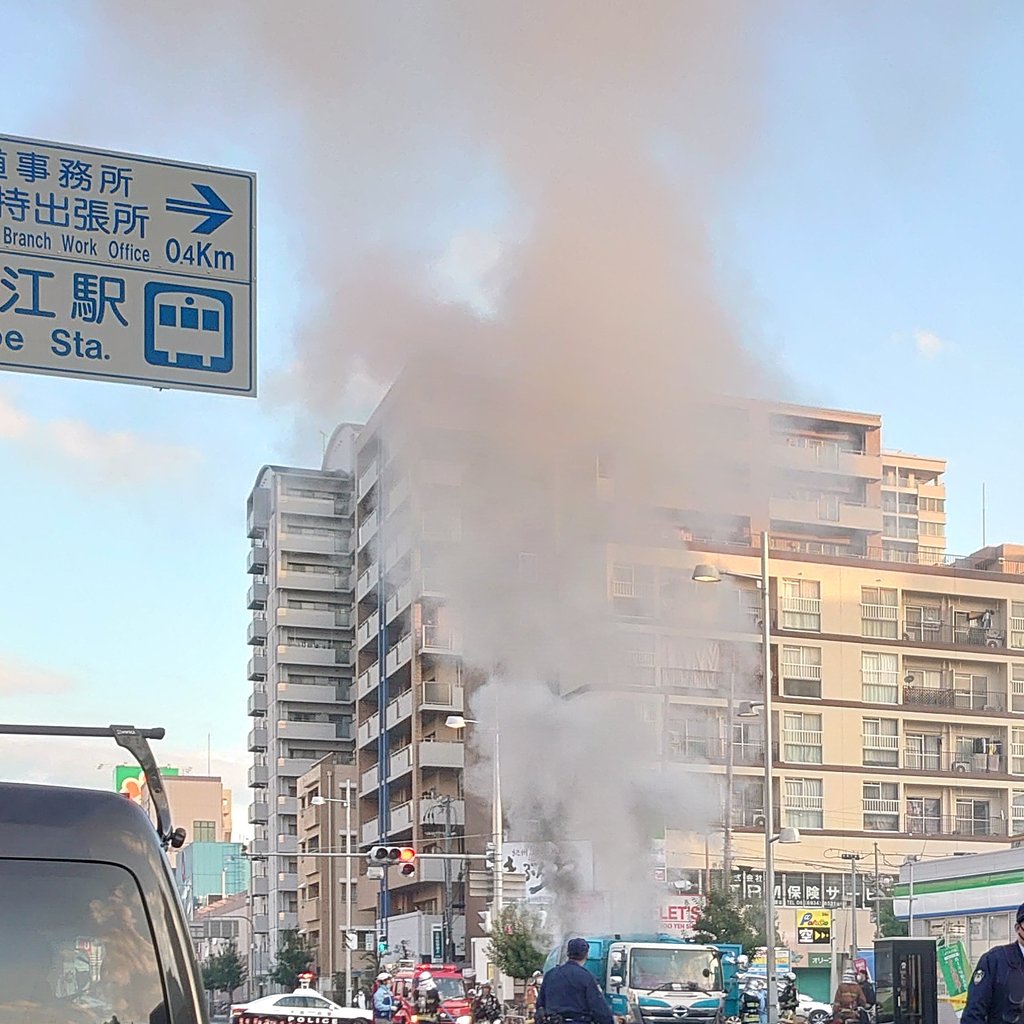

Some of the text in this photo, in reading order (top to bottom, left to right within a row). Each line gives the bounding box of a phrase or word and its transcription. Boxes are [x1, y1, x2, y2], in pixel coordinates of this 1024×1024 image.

[3, 226, 51, 250] Branch
[62, 234, 98, 256] Work
[108, 241, 151, 263] Office
[0, 265, 129, 328] 江駅
[51, 328, 111, 361] Sta.
[287, 1016, 338, 1024] POLICE
